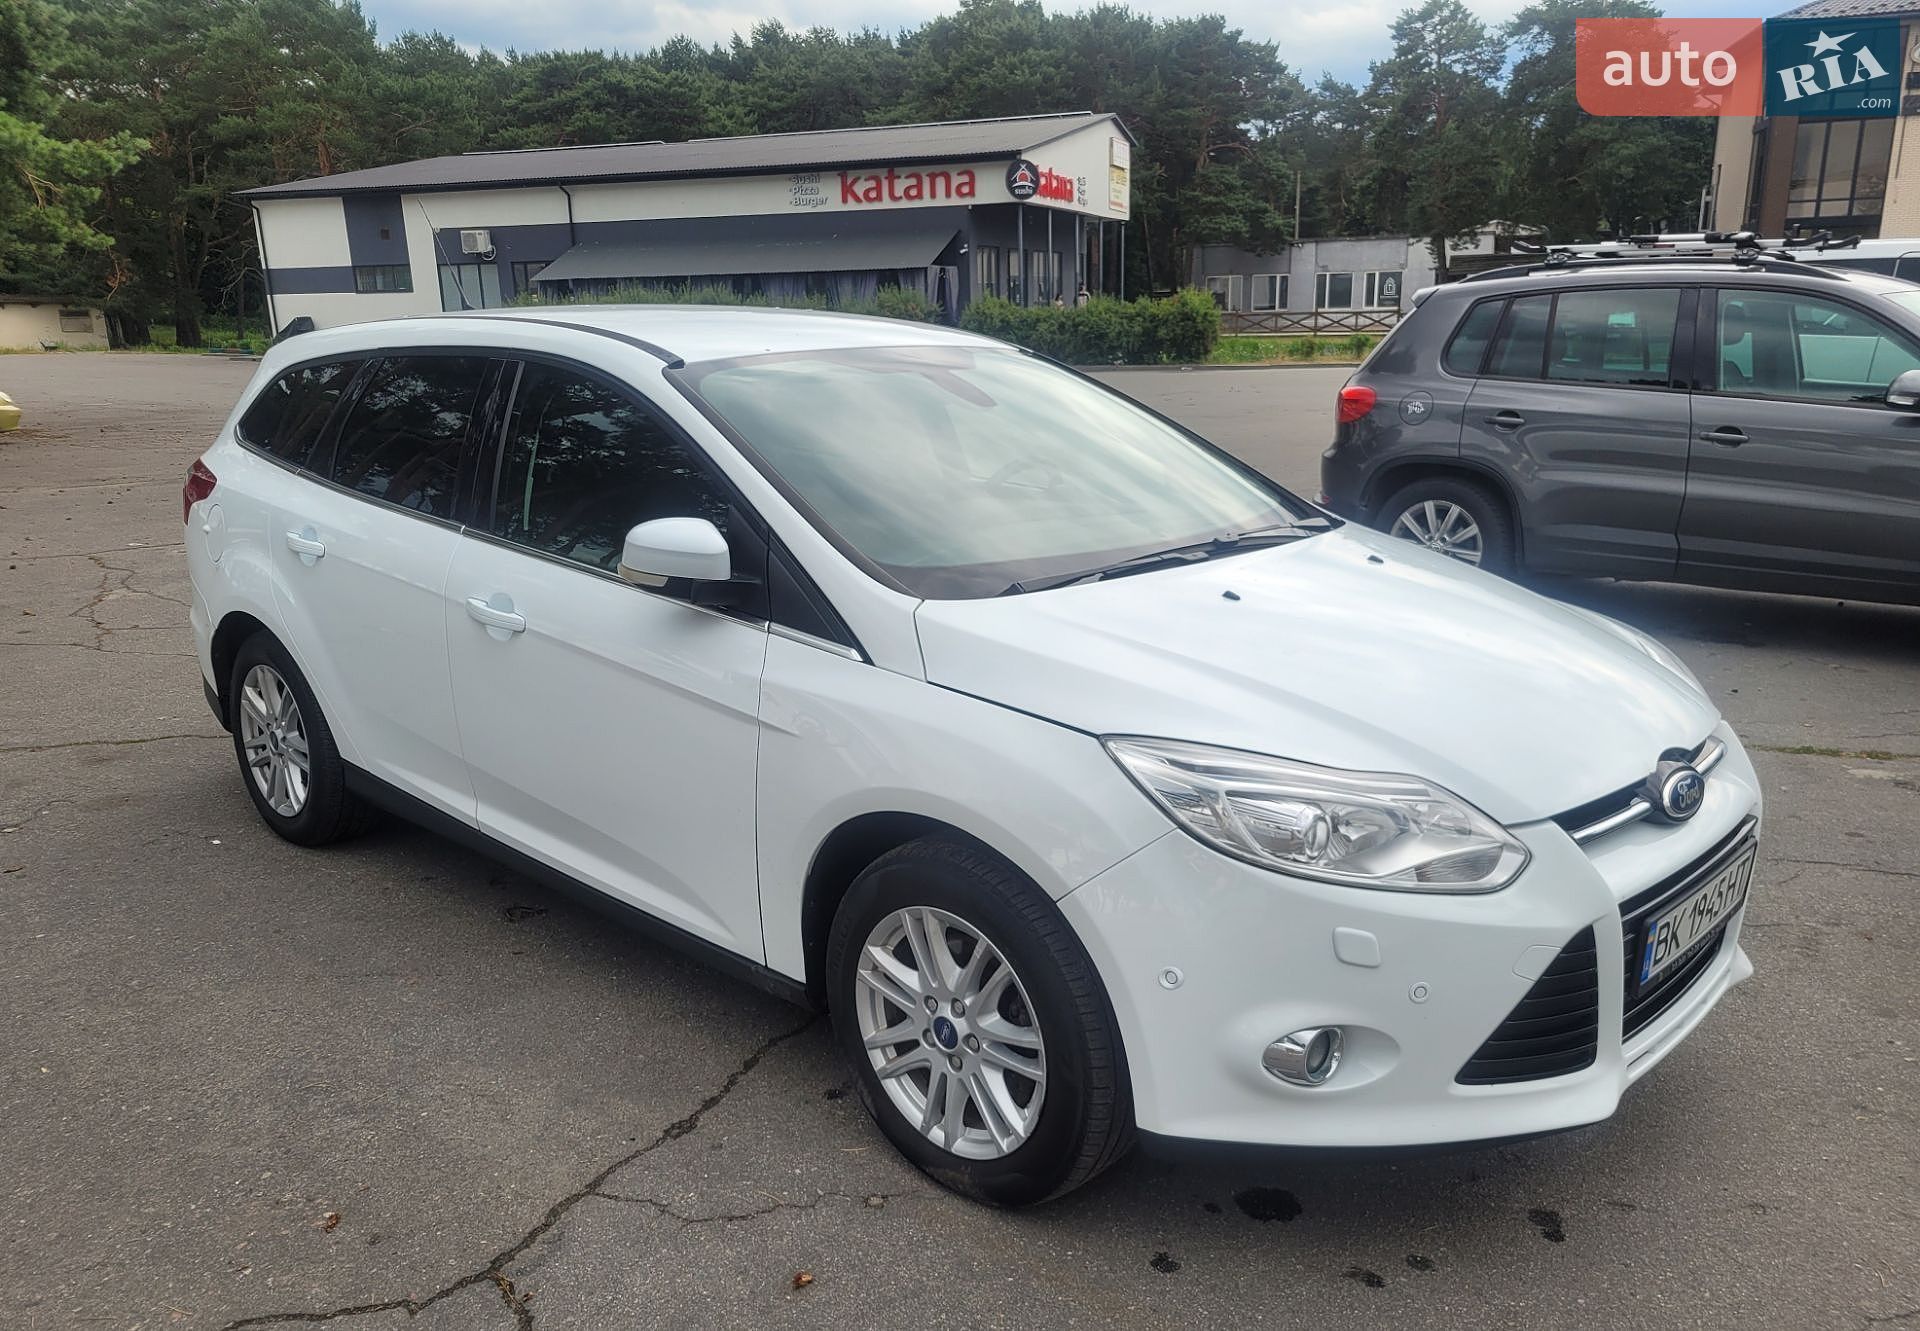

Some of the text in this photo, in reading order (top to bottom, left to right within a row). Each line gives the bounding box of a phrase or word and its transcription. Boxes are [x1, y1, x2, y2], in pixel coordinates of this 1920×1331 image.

[837, 167, 977, 205] katana
[1036, 165, 1074, 203] atana
[1678, 778, 1700, 809] Ford
[1653, 907, 1688, 968] BK
